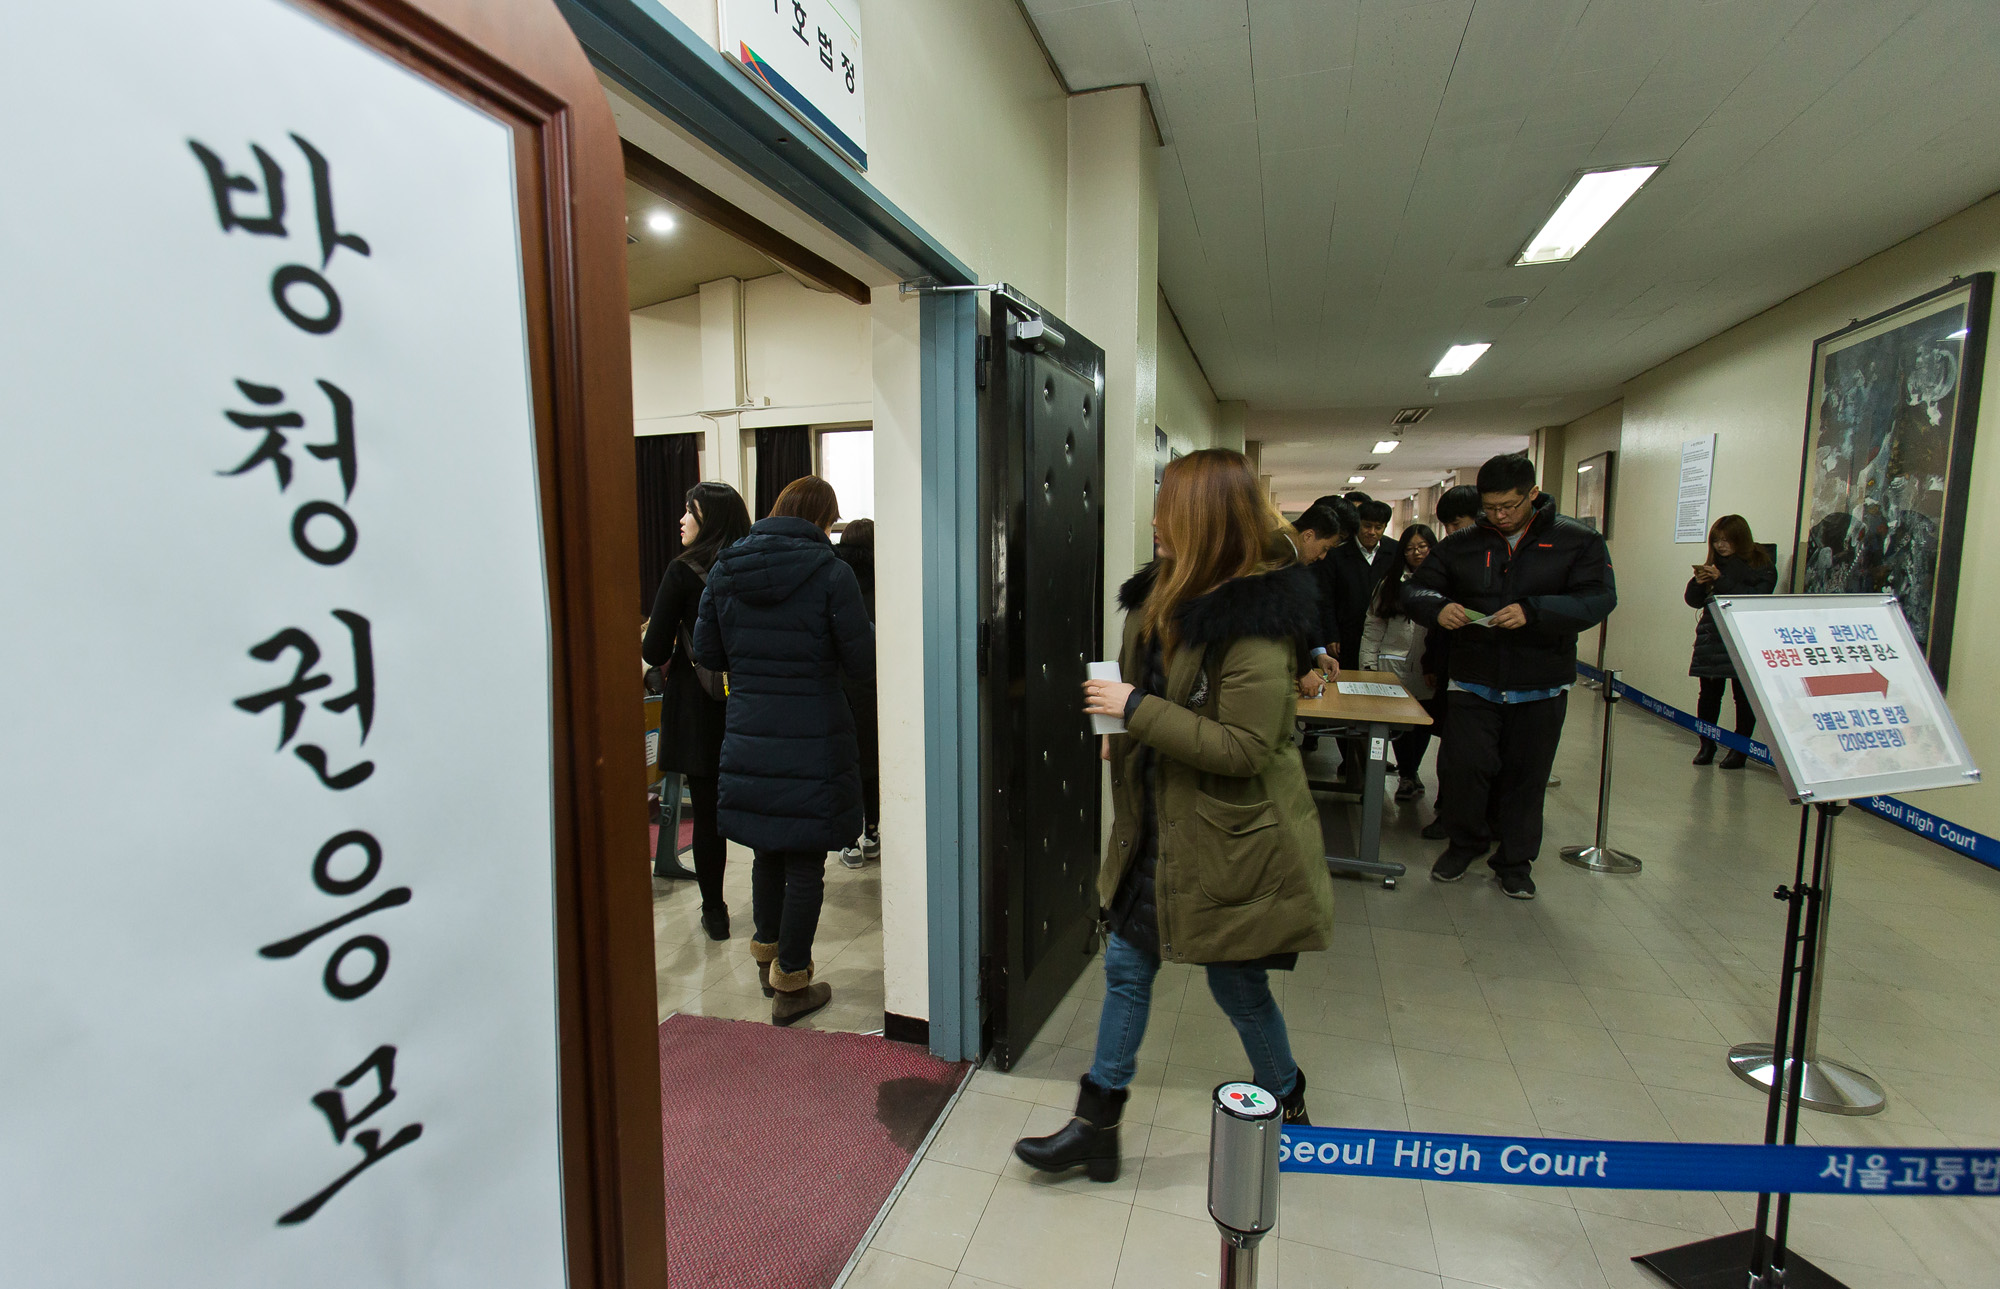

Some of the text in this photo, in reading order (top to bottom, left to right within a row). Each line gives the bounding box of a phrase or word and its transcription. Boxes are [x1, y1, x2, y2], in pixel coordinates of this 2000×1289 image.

[1828, 624, 1879, 643] 관련사건
[1761, 643, 1899, 669] 방청권 응모 및 추첨 장소
[1812, 705, 1910, 731] 3별관 제1호 법정
[1749, 742, 1768, 759] Seoul
[1871, 795, 1977, 851] Seoul High Court
[1279, 1133, 1608, 1178] Seoul High Court
